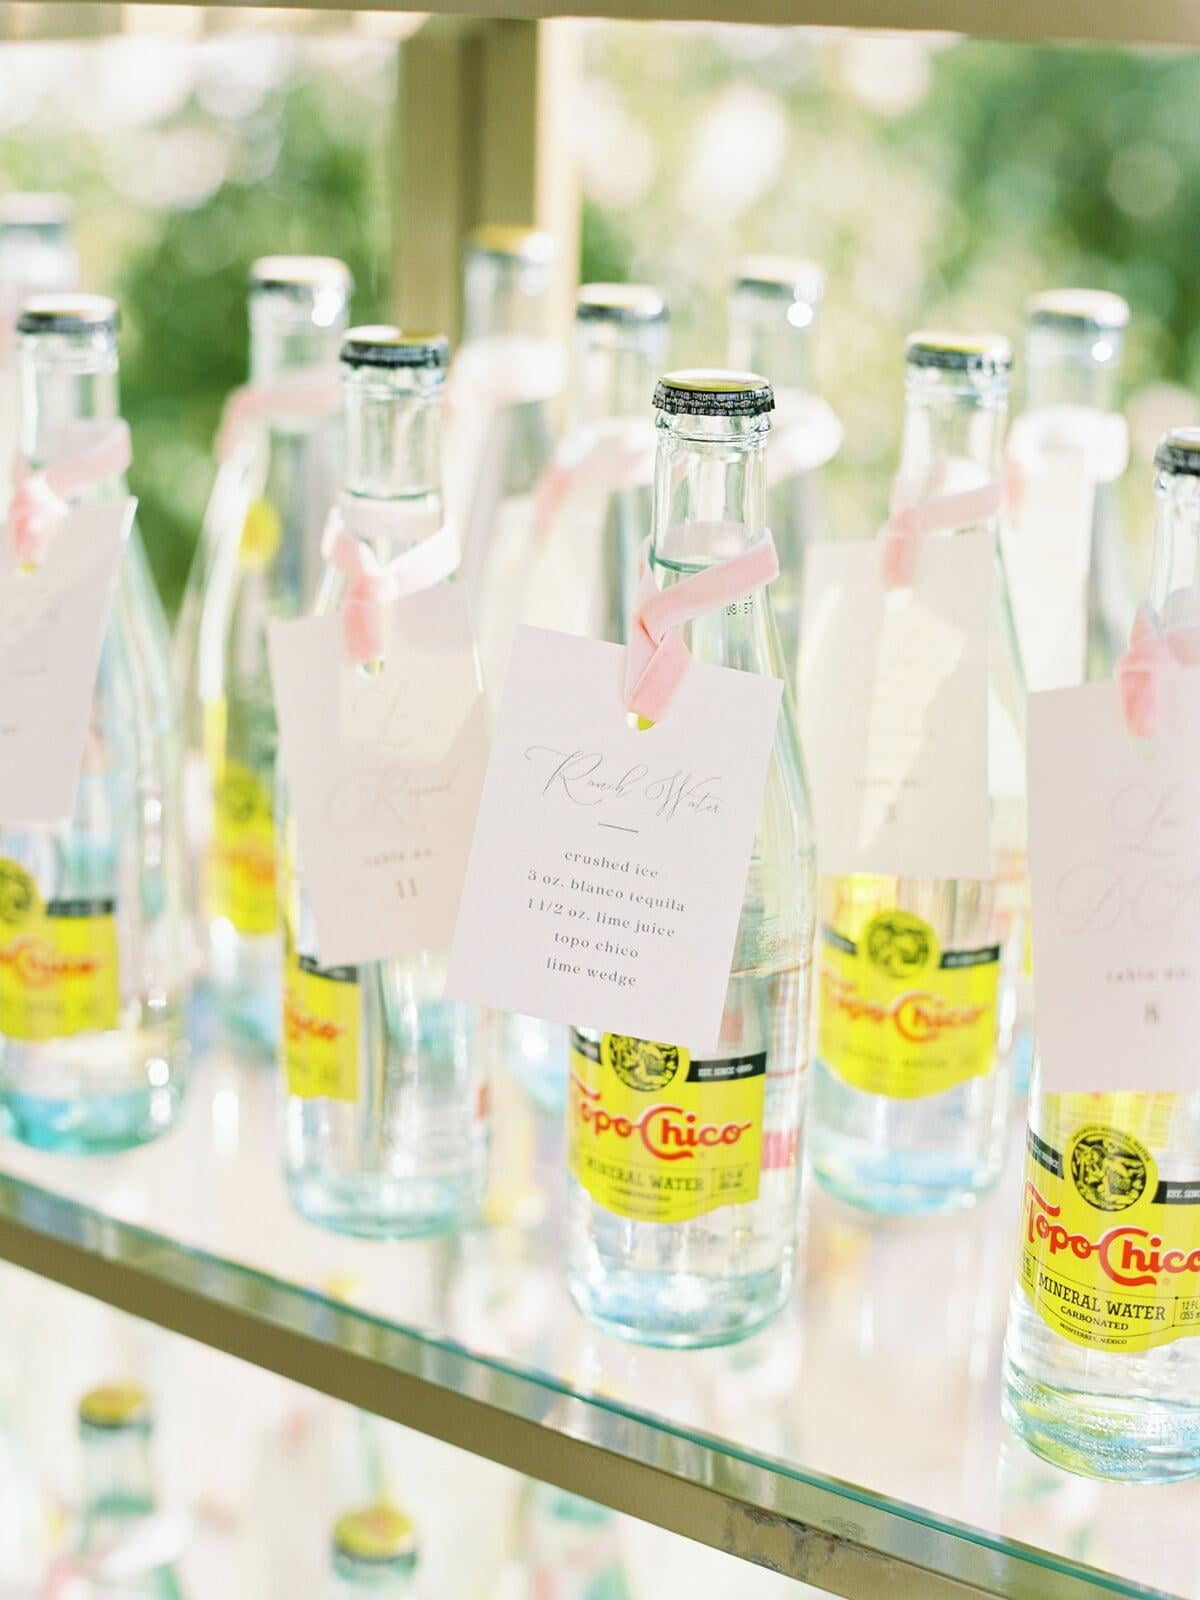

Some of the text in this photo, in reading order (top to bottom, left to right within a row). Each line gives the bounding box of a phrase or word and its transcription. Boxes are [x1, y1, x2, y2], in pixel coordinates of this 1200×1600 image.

[525, 745, 649, 806] Ranch
[645, 769, 724, 821] Water
[564, 850, 660, 879] crushed ice
[527, 869, 686, 913] 3 oz. blanco tequila
[527, 897, 676, 938] 1 1/2 oz. lime juice
[554, 932, 639, 959] topo chico
[546, 957, 637, 987] lime wedge
[640, 1105, 752, 1161] Chico
[650, 1176, 705, 1192] WATER
[1025, 1179, 1098, 1260] Topo
[1038, 1271, 1166, 1321] MINERAL WATER
[1060, 1305, 1129, 1331] CARBONATED
